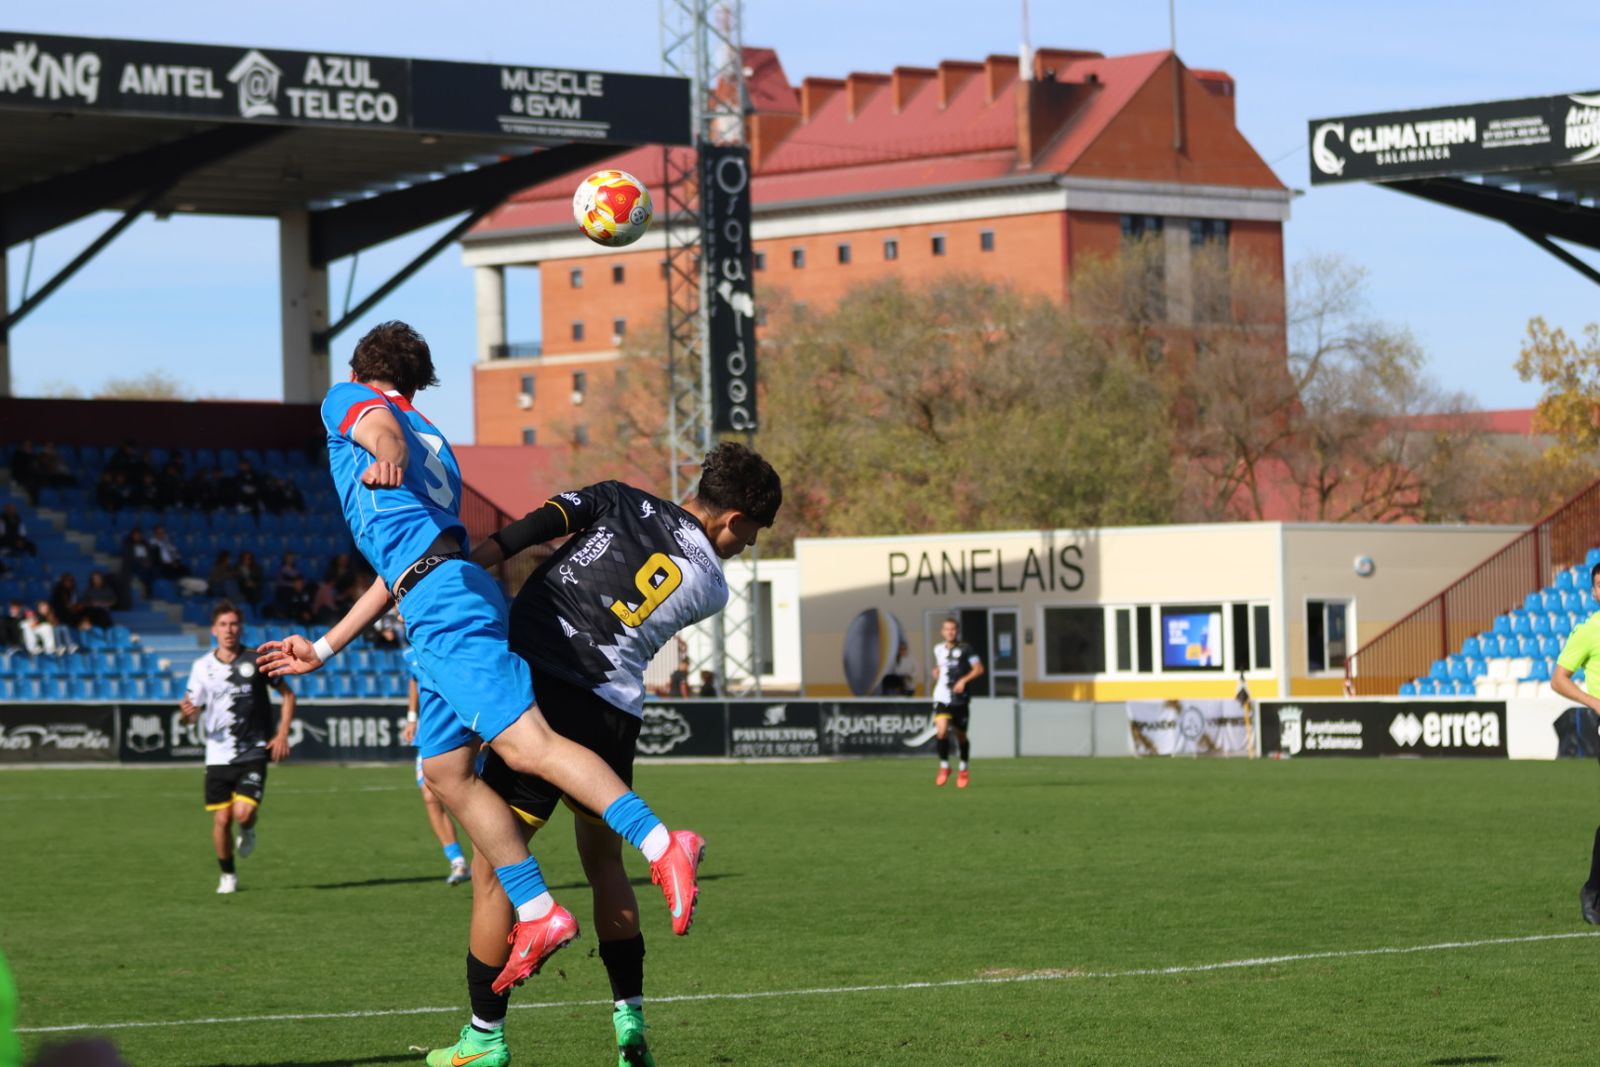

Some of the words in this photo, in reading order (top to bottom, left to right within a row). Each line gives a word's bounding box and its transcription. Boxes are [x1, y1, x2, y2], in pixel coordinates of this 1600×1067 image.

[119, 64, 223, 99] AMTEL
[303, 55, 379, 89] AZUL
[501, 68, 603, 97] MUSCLE
[286, 88, 398, 123] TELECO
[526, 94, 582, 119] GYM
[1349, 116, 1477, 154] CLIMATERM
[569, 526, 606, 563] TERNERA
[579, 532, 614, 566] CHARRA
[888, 545, 1085, 596] PANELAIS
[609, 552, 683, 628] 9
[326, 717, 392, 747] TAPAS
[1422, 711, 1500, 748] errea
